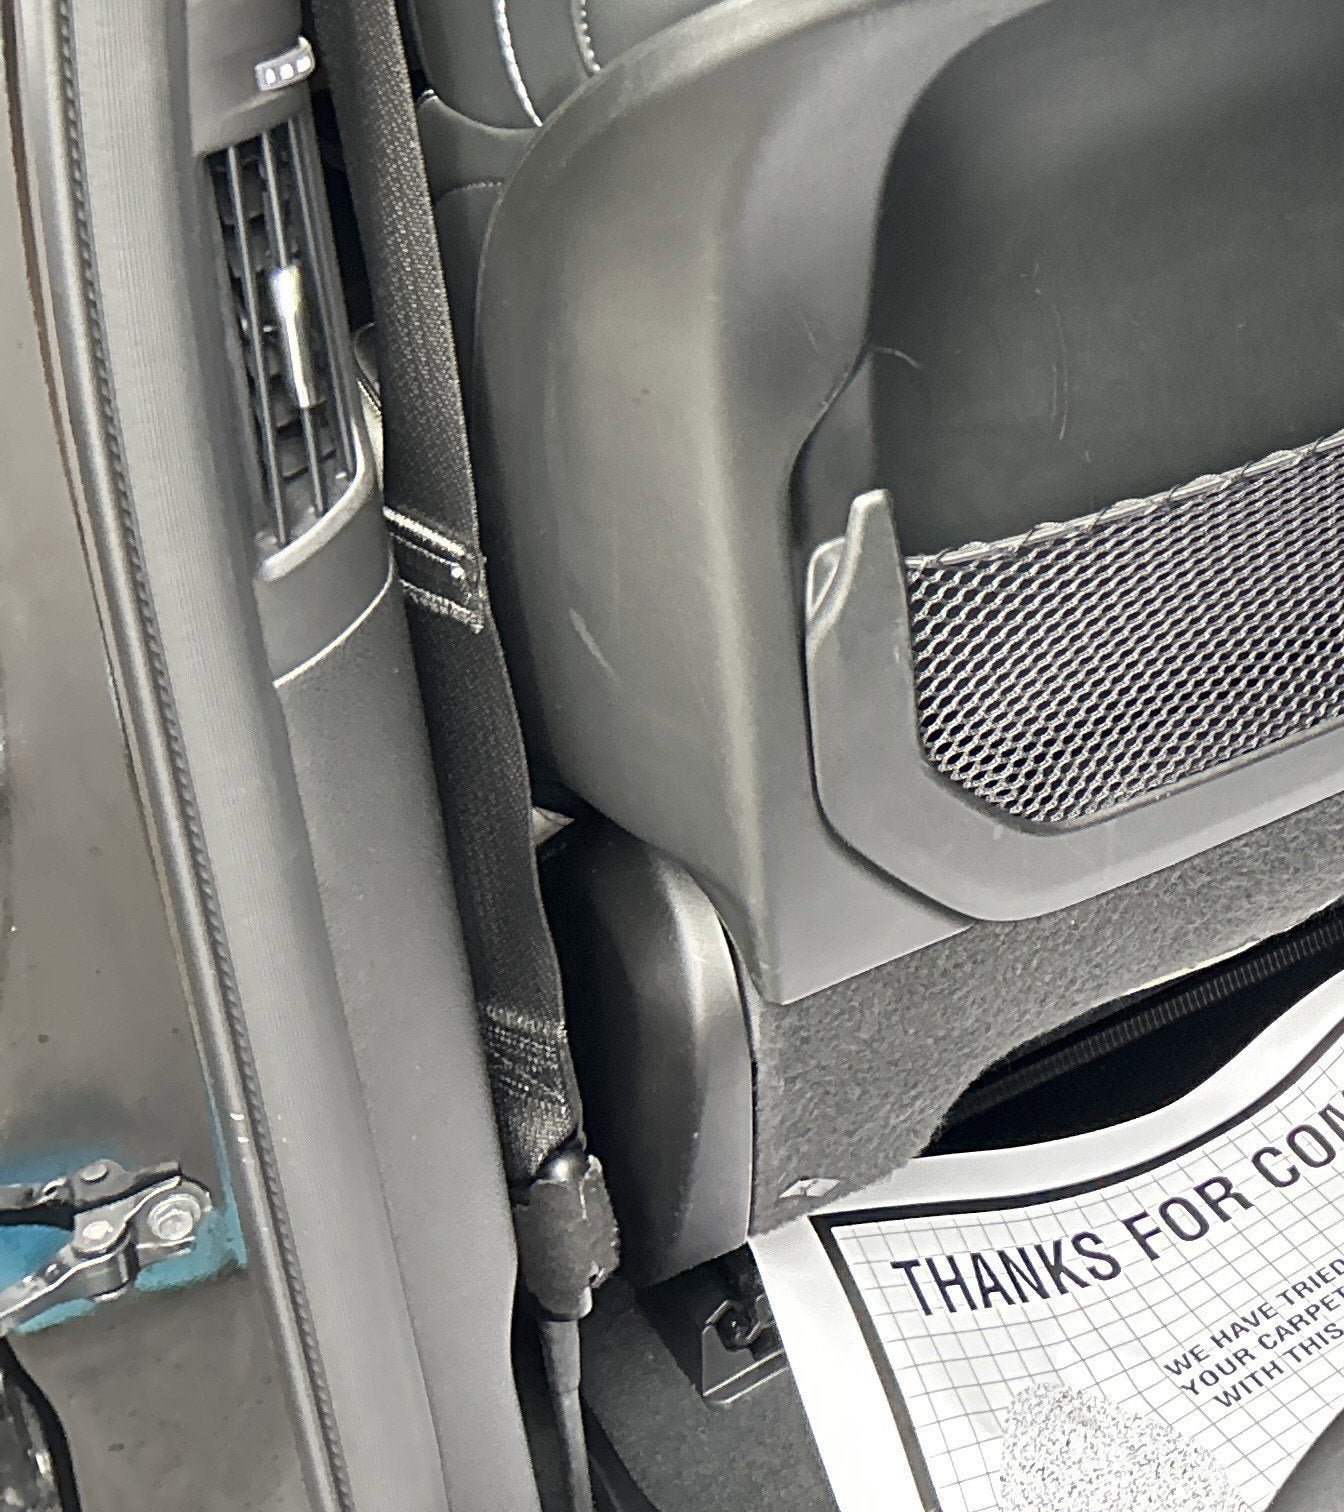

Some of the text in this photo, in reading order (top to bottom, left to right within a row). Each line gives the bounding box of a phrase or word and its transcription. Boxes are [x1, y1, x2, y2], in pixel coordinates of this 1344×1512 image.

[890, 1229, 1122, 1316] THANKS
[1122, 1174, 1253, 1262] FOR
[1164, 1344, 1212, 1376] WE
[1210, 1302, 1280, 1349] HAVE
[1180, 1348, 1257, 1396] YOUR
[1213, 1359, 1285, 1408] WITH
[1282, 1322, 1344, 1364] THIS
